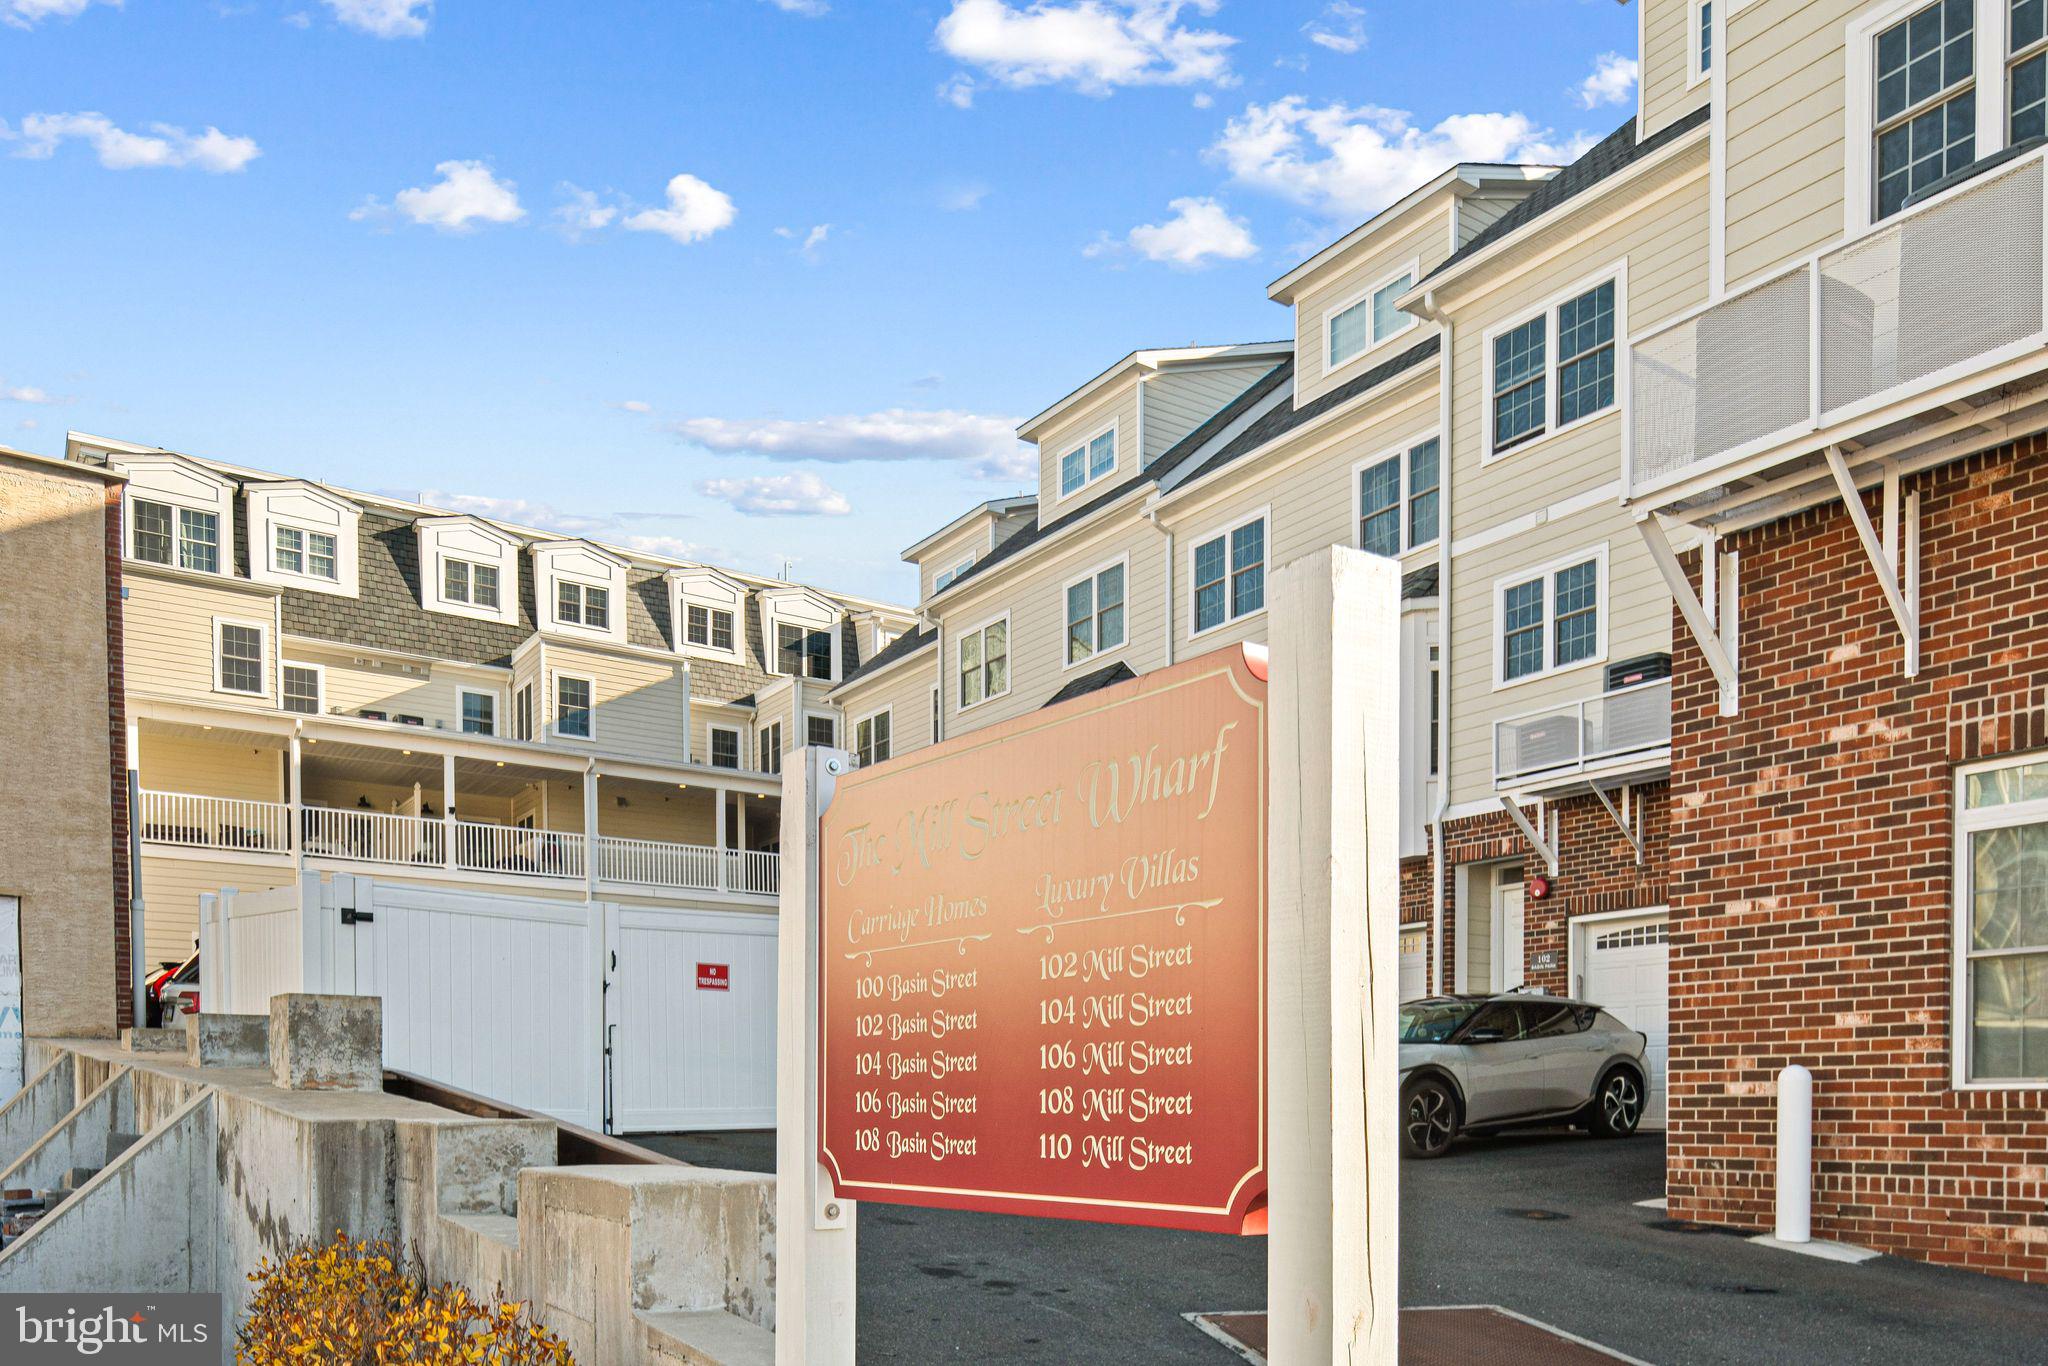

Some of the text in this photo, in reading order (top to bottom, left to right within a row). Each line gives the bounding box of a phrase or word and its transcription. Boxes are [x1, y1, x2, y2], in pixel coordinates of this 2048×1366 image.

[836, 720, 1239, 886] The Mill Street Wharf
[1035, 848, 1200, 918] Luxury Villas
[848, 893, 988, 943] Carriage Homes
[709, 967, 717, 976] NO
[1039, 941, 1192, 982] 102 Mill Street
[1538, 954, 1551, 963] 102
[698, 977, 728, 987] TRESPASSING
[856, 967, 977, 1001] 100 Basin Street
[856, 1009, 977, 1040] 102 Basin Street
[1039, 992, 1192, 1029] 104 Mill Street
[855, 1050, 977, 1080] 104 Basin Street
[1039, 1039, 1192, 1075] 106 Mill Street
[855, 1088, 977, 1120] 106 Basin Street
[1039, 1085, 1192, 1123] 108 Mill Street
[855, 1127, 977, 1161] 108 Basin Street
[1039, 1133, 1192, 1171] 110 Mill Street
